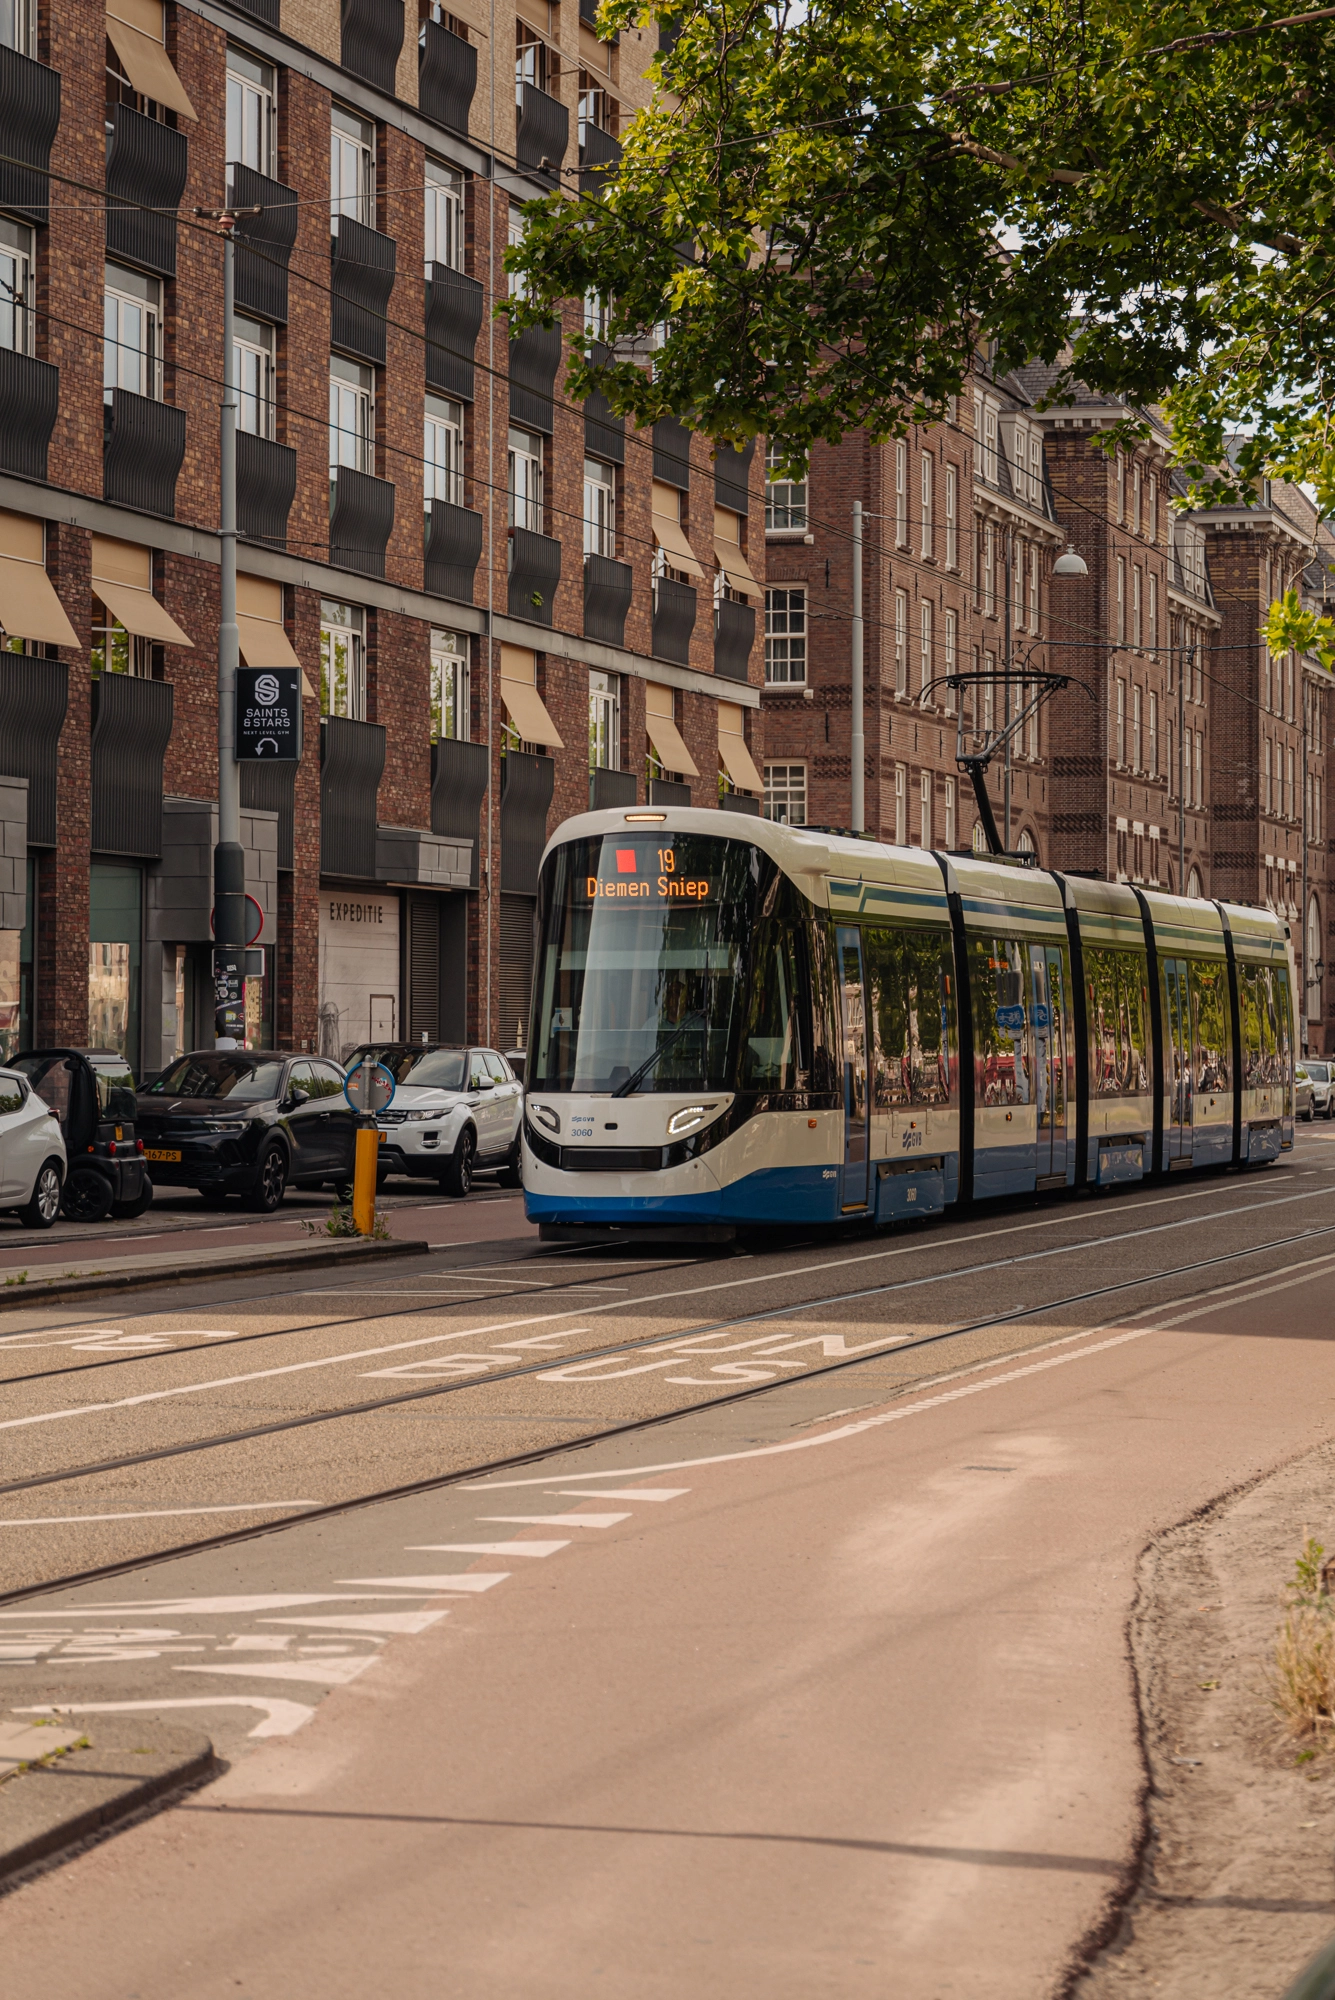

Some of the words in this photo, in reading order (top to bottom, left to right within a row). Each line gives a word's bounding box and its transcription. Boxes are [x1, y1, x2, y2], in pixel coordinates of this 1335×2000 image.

[246, 708, 288, 718] SAINTS
[243, 718, 251, 728] &
[253, 718, 291, 728] STARS
[657, 848, 676, 873] 19
[587, 877, 650, 898] Diemen
[657, 876, 709, 900] Sniep
[329, 902, 383, 924] EXPEDITIE
[571, 1128, 593, 1137] 3060
[907, 1187, 918, 1202] 3060
[356, 1353, 809, 1385] BUS
